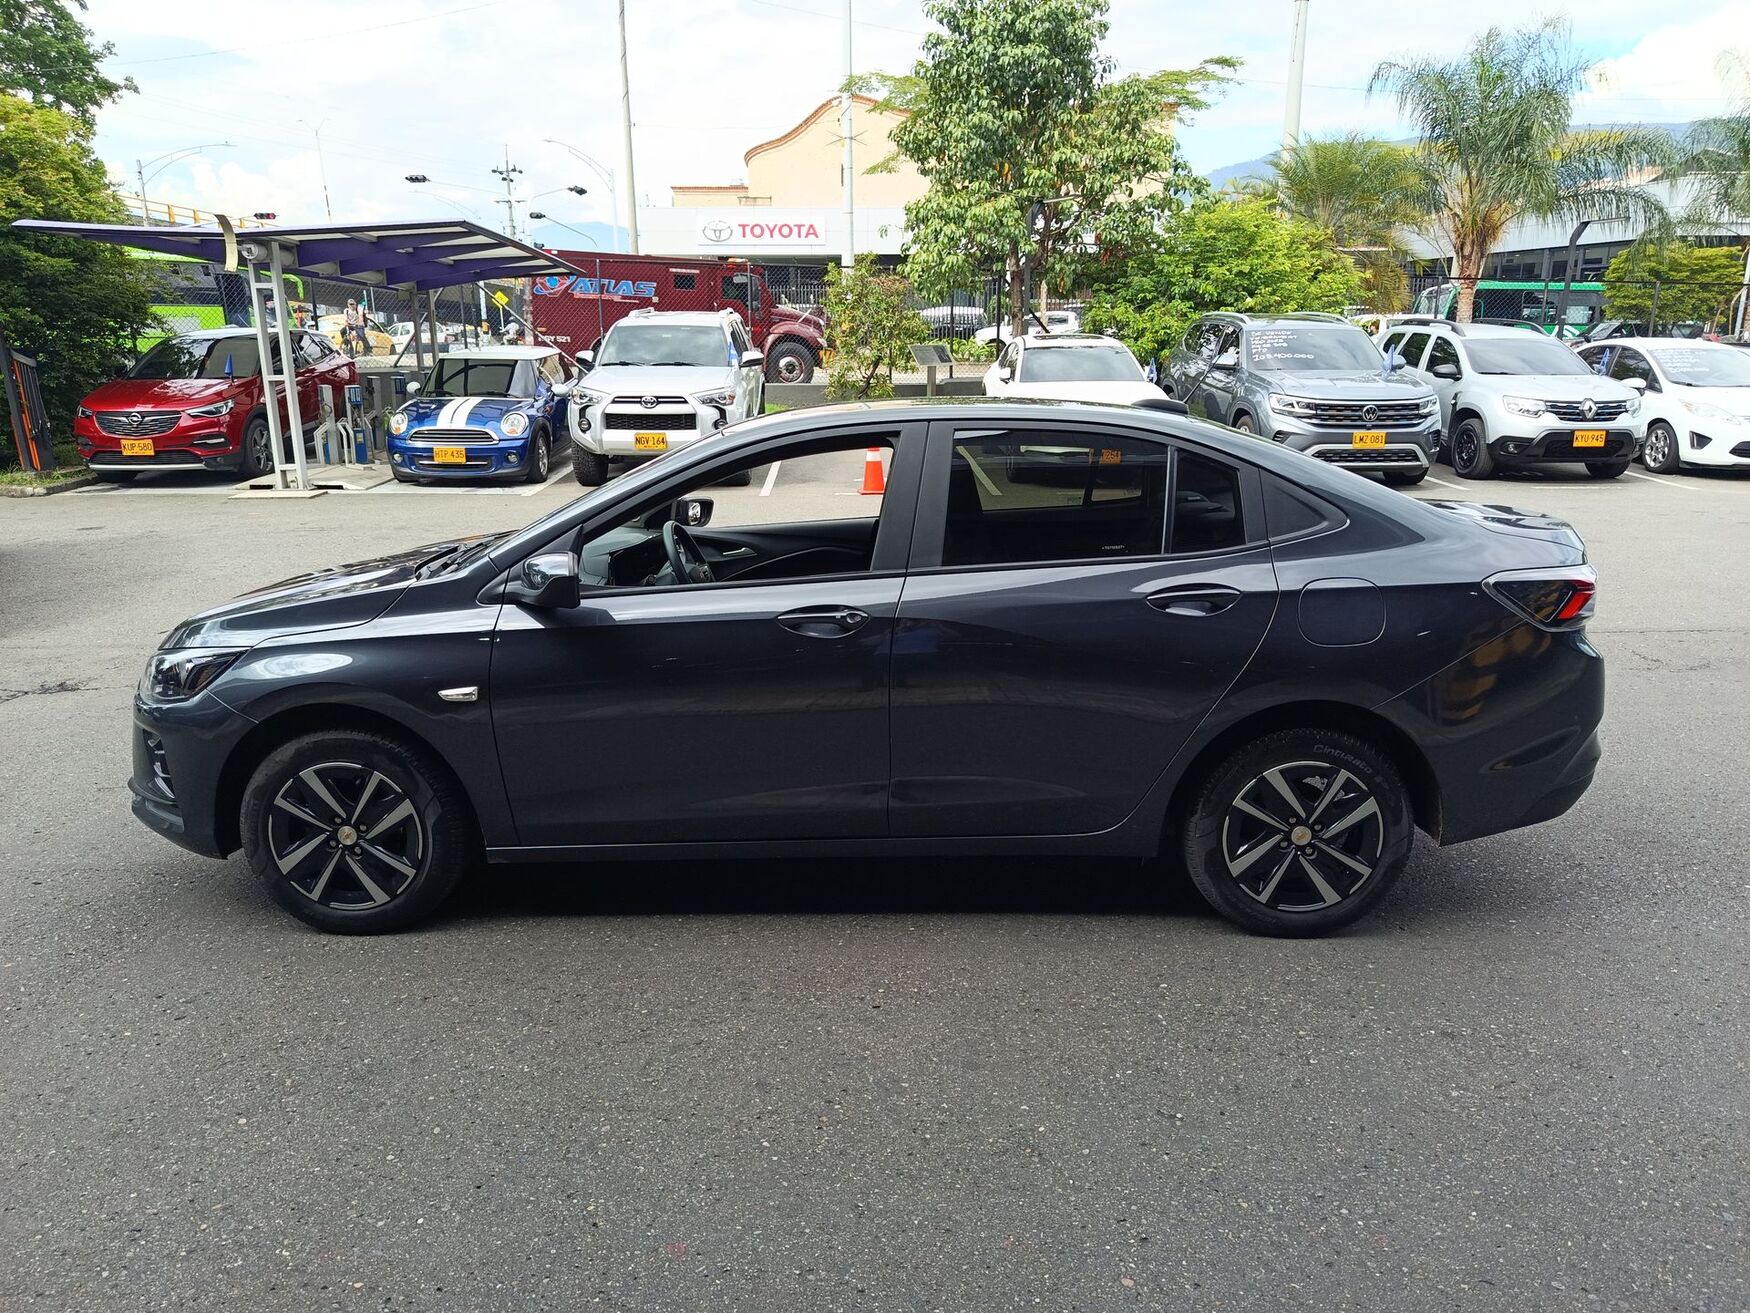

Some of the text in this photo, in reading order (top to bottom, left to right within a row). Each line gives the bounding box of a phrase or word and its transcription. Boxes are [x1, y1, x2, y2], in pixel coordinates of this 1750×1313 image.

[738, 223, 819, 239] TOYOTA
[568, 277, 657, 297] ATLAS
[556, 335, 571, 343] 521
[635, 436, 666, 446] NGV 164
[1353, 435, 1384, 444] LMZ 081
[1574, 434, 1604, 443] KYU 945
[122, 442, 153, 452] KUP 580
[435, 449, 465, 459] HTP 435
[1313, 744, 1373, 774] Cinturato
